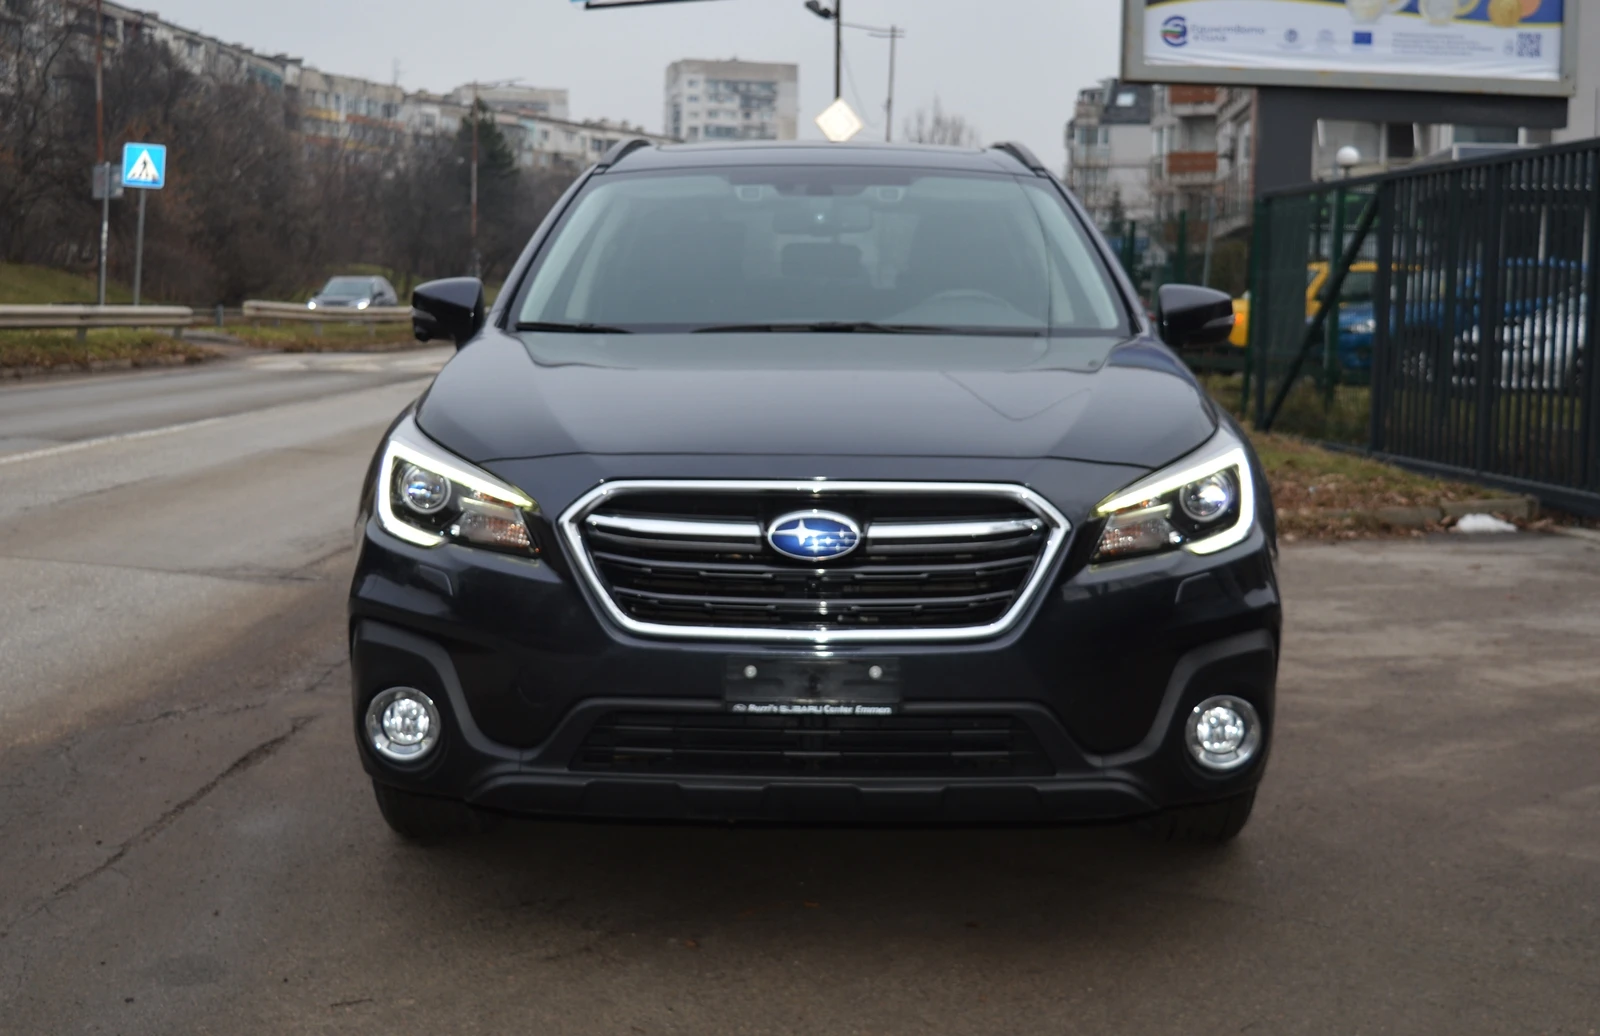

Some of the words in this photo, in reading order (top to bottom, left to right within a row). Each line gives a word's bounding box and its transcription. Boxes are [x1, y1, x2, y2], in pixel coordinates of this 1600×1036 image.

[779, 705, 822, 715] SUBARU
[824, 705, 854, 715] Center
[855, 705, 892, 715] Emmen
